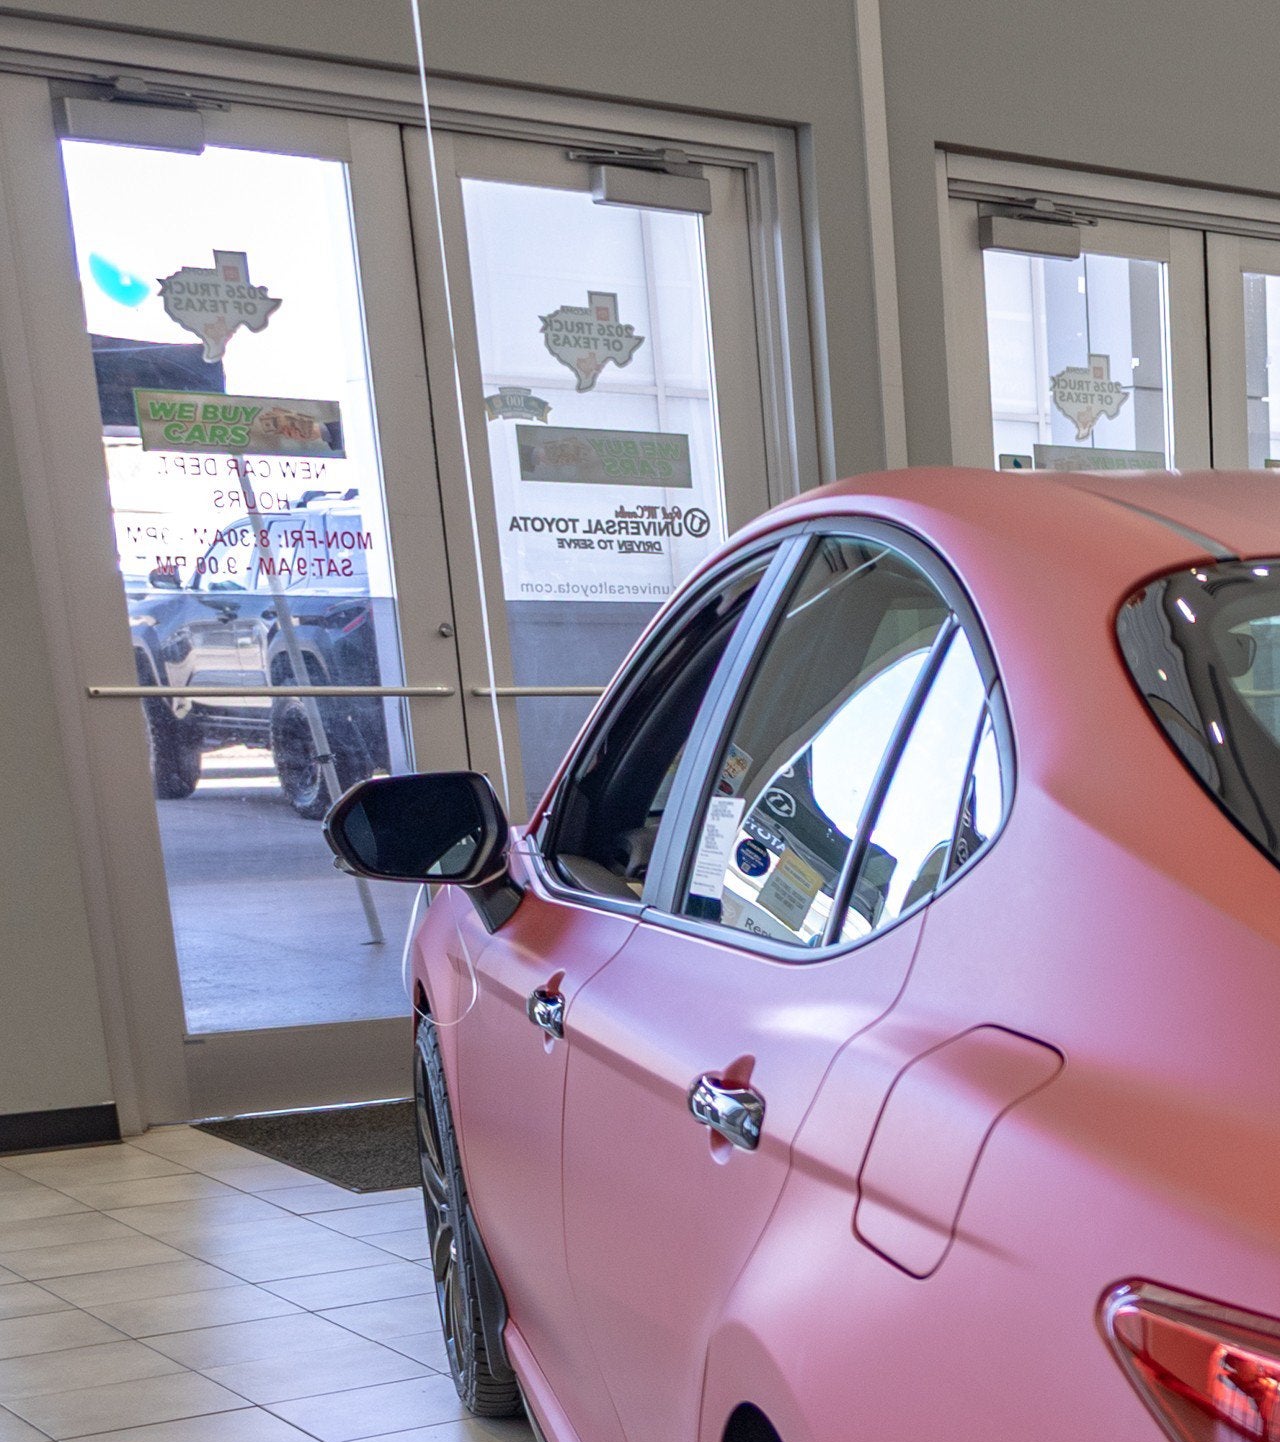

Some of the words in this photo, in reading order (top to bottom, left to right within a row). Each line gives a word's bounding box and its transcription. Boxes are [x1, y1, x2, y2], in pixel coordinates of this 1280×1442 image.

[149, 401, 196, 421] WE
[201, 403, 261, 424] BUY
[163, 422, 251, 446] CARS
